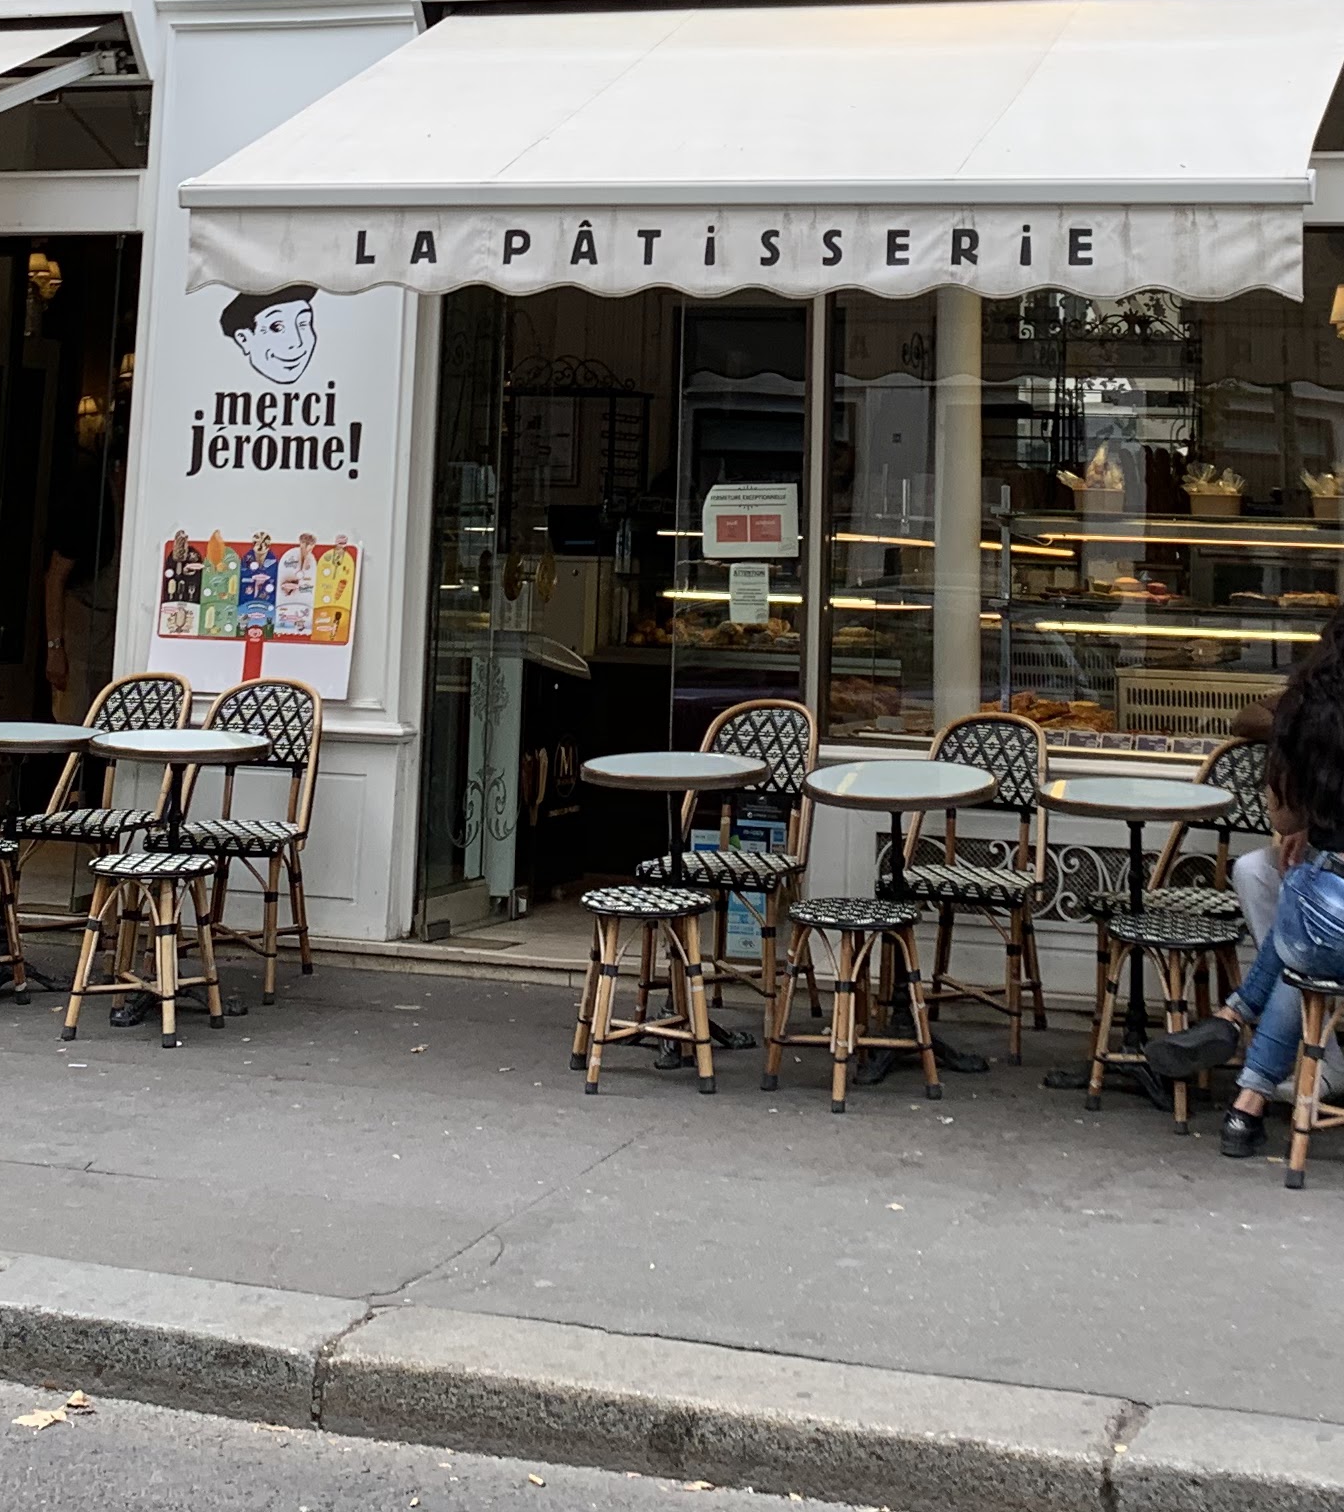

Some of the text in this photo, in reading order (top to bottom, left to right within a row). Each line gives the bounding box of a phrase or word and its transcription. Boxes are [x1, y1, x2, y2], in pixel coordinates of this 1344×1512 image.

[355, 228, 439, 266] LA
[213, 380, 336, 427] merci
[186, 410, 362, 480] jérôme!
